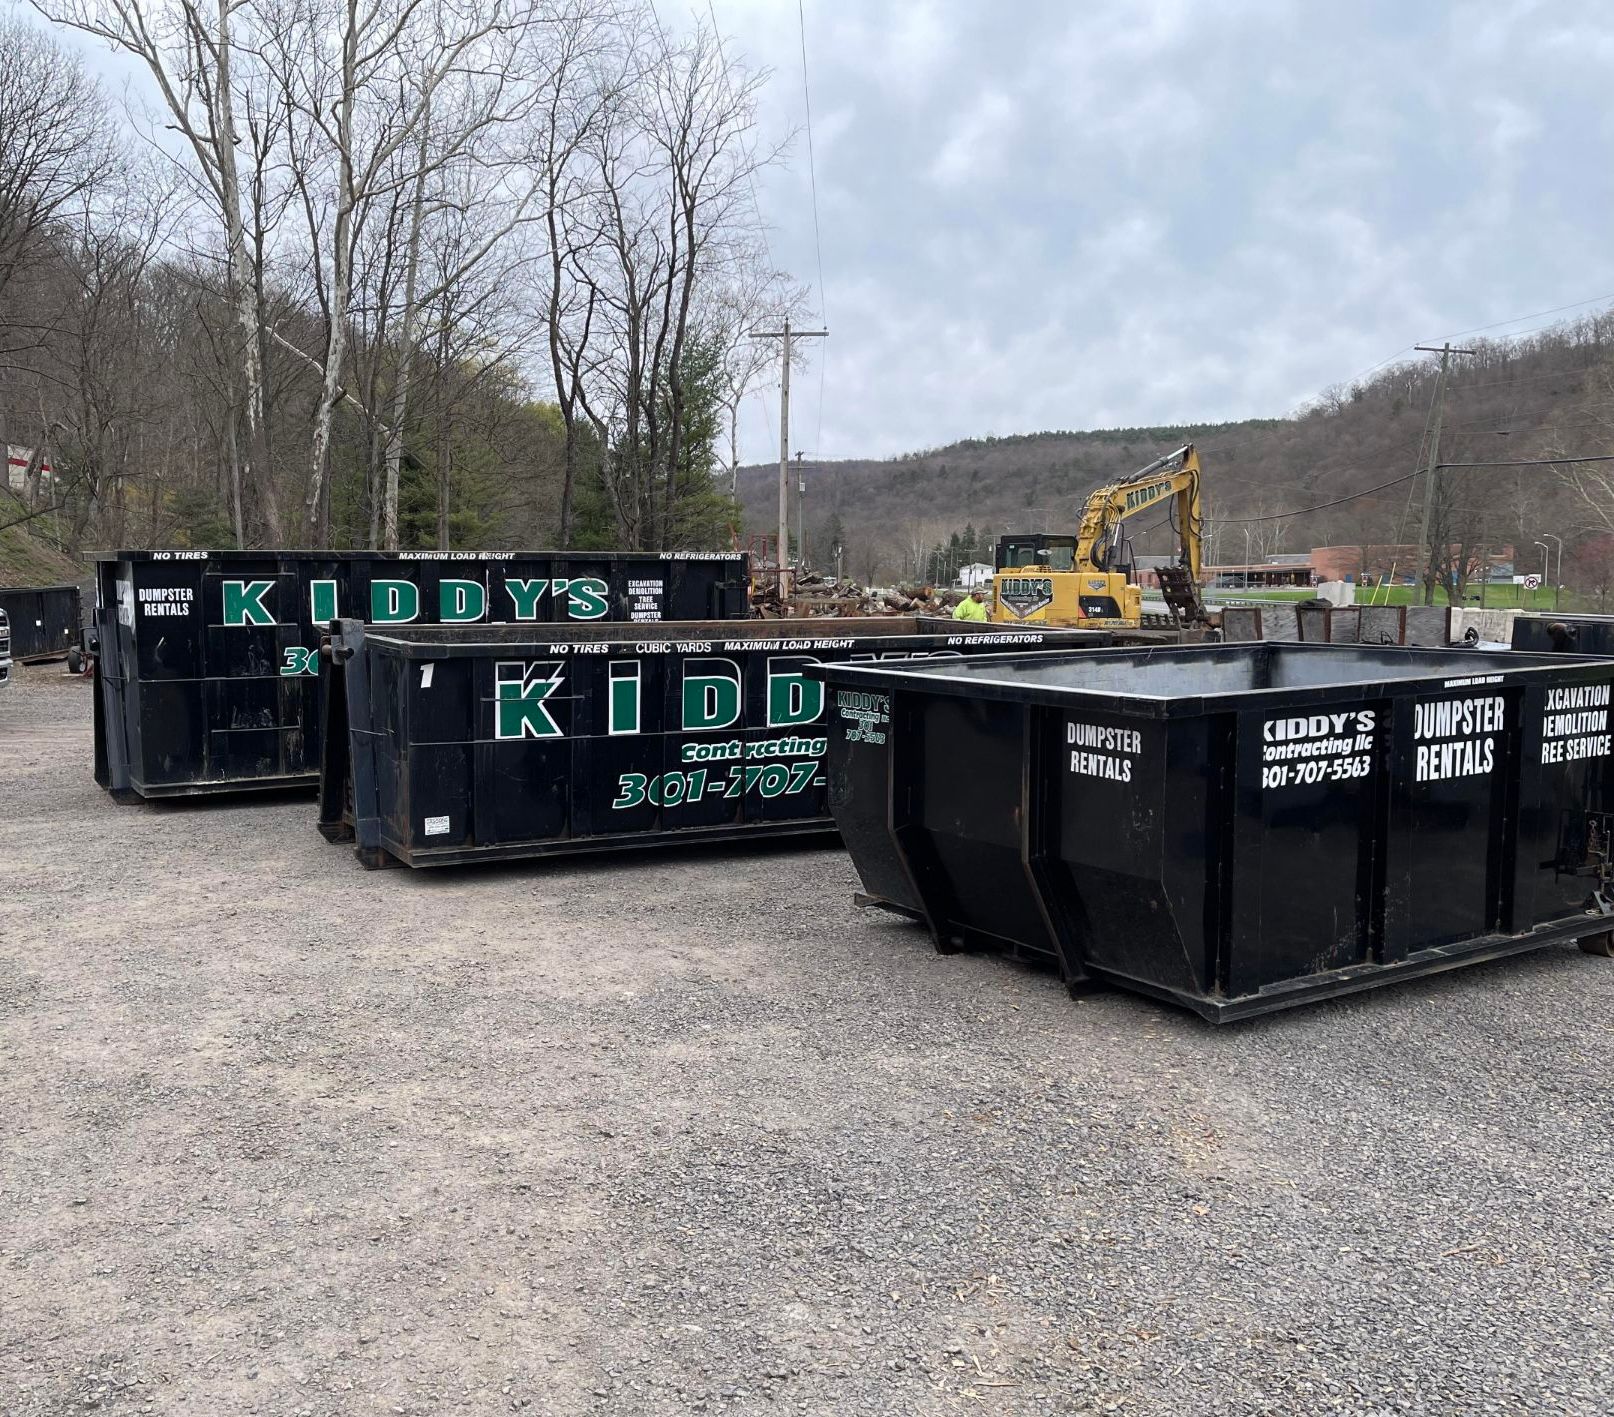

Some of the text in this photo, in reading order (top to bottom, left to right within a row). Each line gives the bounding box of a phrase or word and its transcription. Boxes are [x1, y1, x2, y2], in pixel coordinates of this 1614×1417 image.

[153, 551, 209, 560] NO TIRES
[398, 552, 515, 560] MAXIMUM LOAD HEIGHT
[659, 552, 742, 560] NO REFRIGERATORS
[138, 588, 194, 602] DUMPSTER
[628, 587, 663, 595] DEMOLITION
[1001, 578, 1053, 595] KIDDY'S
[144, 603, 190, 616] RENTALS
[222, 577, 609, 625] KIDDY'S
[630, 611, 661, 619] DUMPSTER
[550, 638, 855, 653] NO TIRES CUBIC YARDS MAXIMUM LOAD HEIGHT
[947, 634, 1044, 645] NO REFRIGERATORS
[420, 663, 434, 689] 1
[1444, 675, 1504, 688] MAXIMUM LOAD HEIGHT
[837, 690, 890, 713] KIDDY'S
[1544, 684, 1611, 711] XCAVATION
[1263, 710, 1376, 742] KIDDY'S
[1414, 696, 1505, 740] DUMPSTER
[1067, 721, 1142, 754] DUMPSTER
[1263, 733, 1374, 761] ontracting llc
[1566, 734, 1612, 761] SERVICE
[1070, 750, 1132, 783] RENTALS
[1416, 737, 1494, 782] RENTALS
